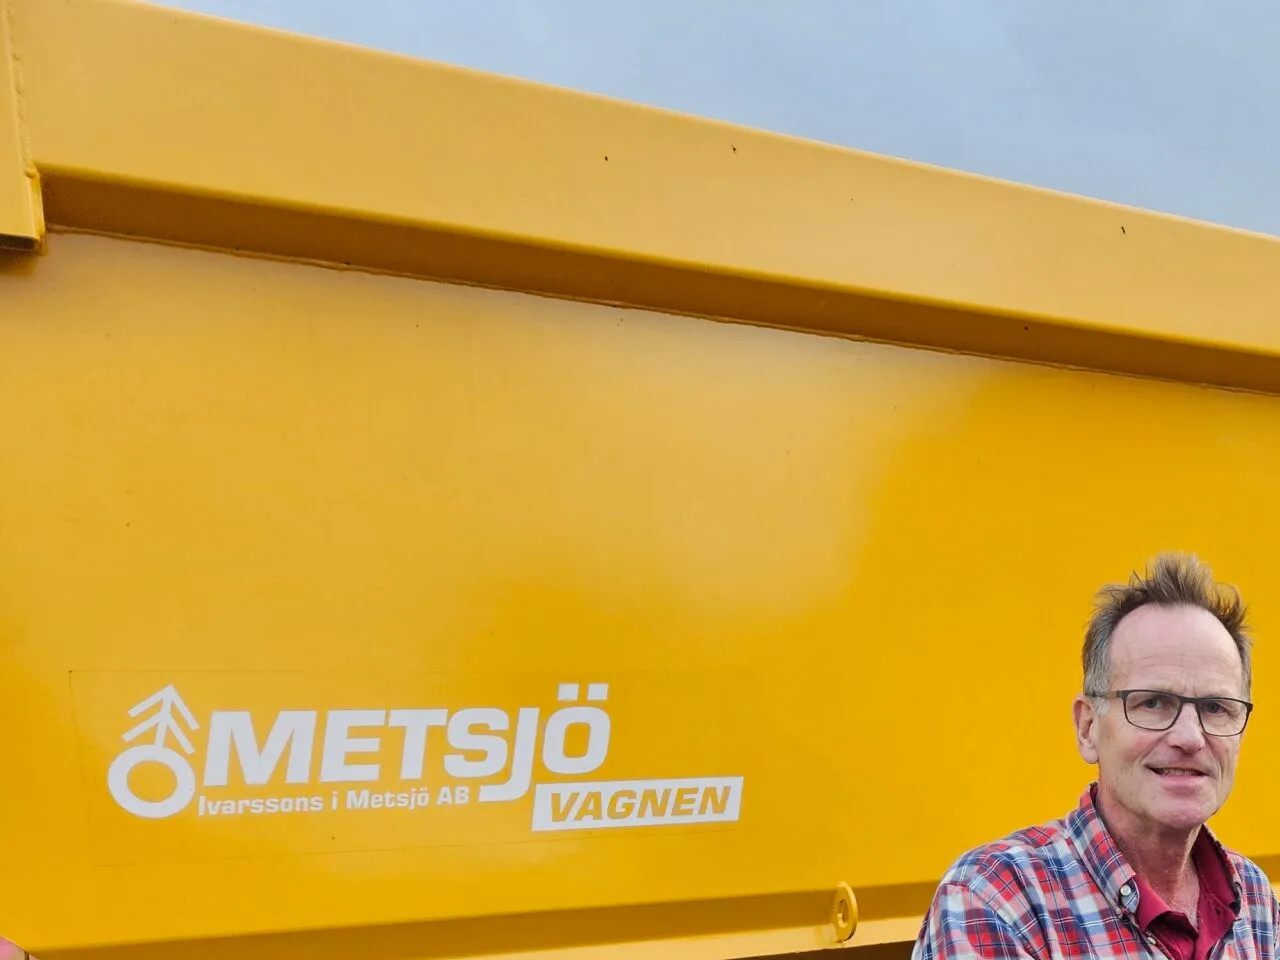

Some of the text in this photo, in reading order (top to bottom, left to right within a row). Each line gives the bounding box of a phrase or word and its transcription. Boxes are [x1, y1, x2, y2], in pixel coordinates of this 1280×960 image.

[203, 684, 609, 802] METSJÖ
[198, 786, 470, 816] Ivarssons i Metsjö AB
[551, 786, 730, 821] VAGNEN
